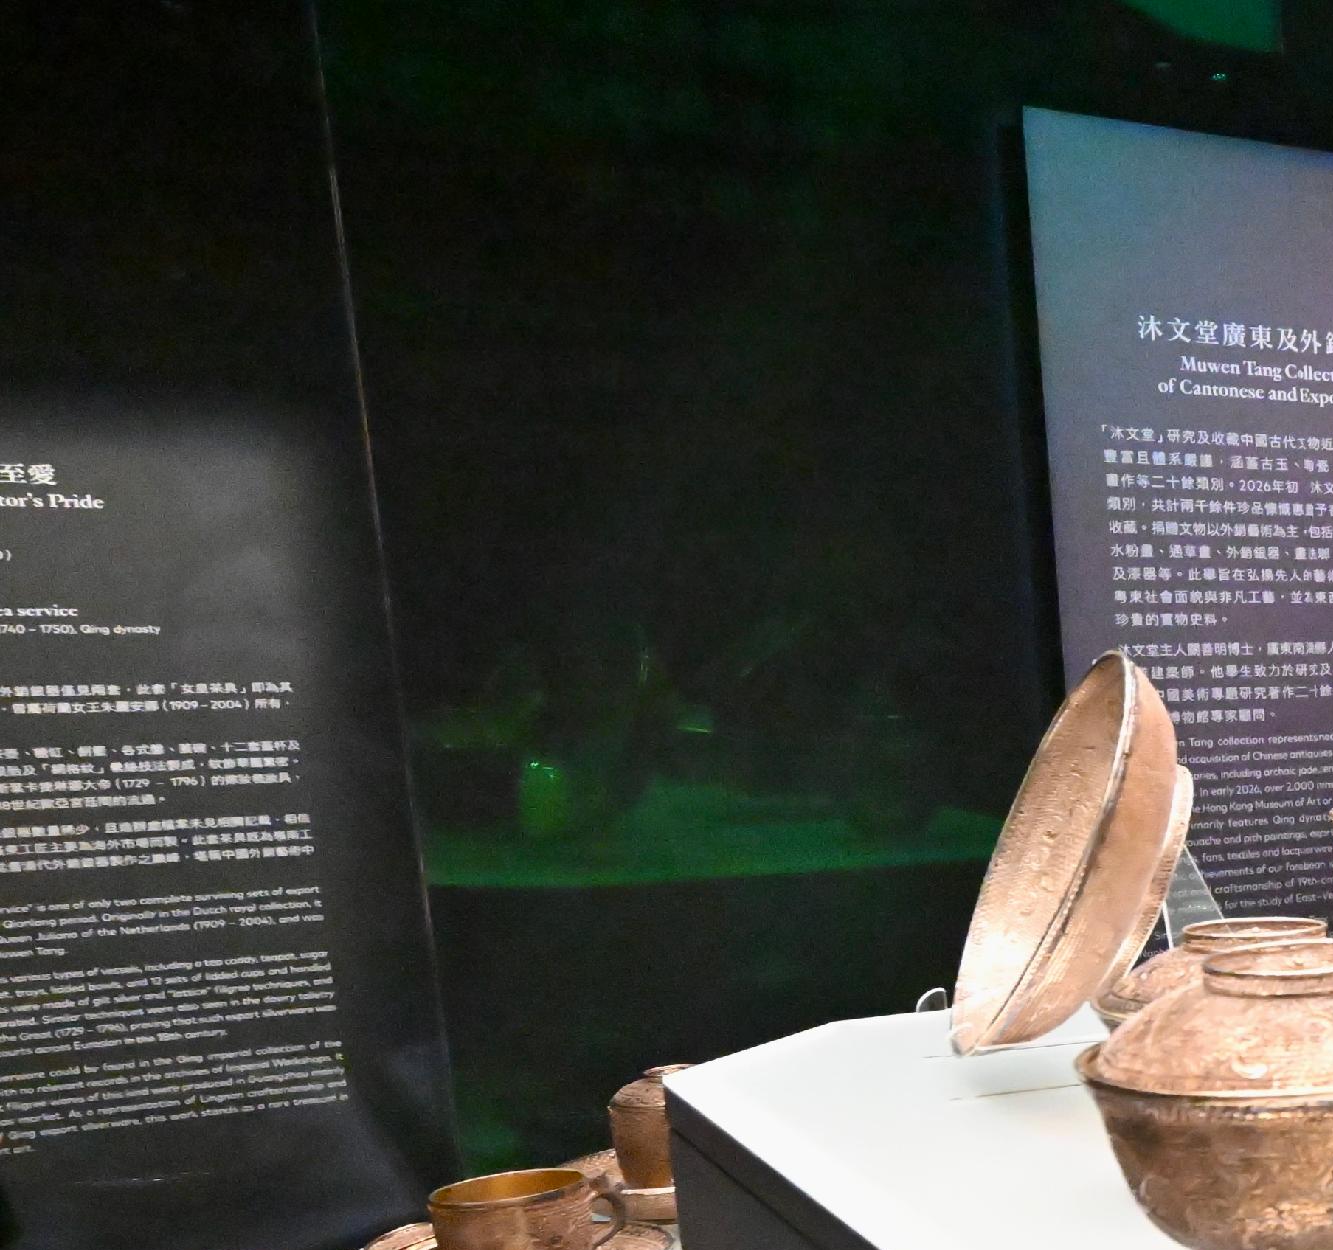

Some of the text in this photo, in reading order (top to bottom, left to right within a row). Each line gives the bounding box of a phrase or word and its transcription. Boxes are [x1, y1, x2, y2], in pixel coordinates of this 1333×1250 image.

[1180, 355, 1240, 375] Muwen
[1244, 360, 1282, 381] Tang
[1157, 378, 1177, 394] of
[1179, 379, 1264, 400] Cantonese
[1268, 386, 1298, 403] and
[47, 493, 104, 509] Pride
[16, 603, 78, 617] service
[113, 624, 161, 636] dynasty
[1188, 737, 1214, 749] Tang
[1217, 735, 1264, 745] collection
[1252, 750, 1288, 760] Chinese
